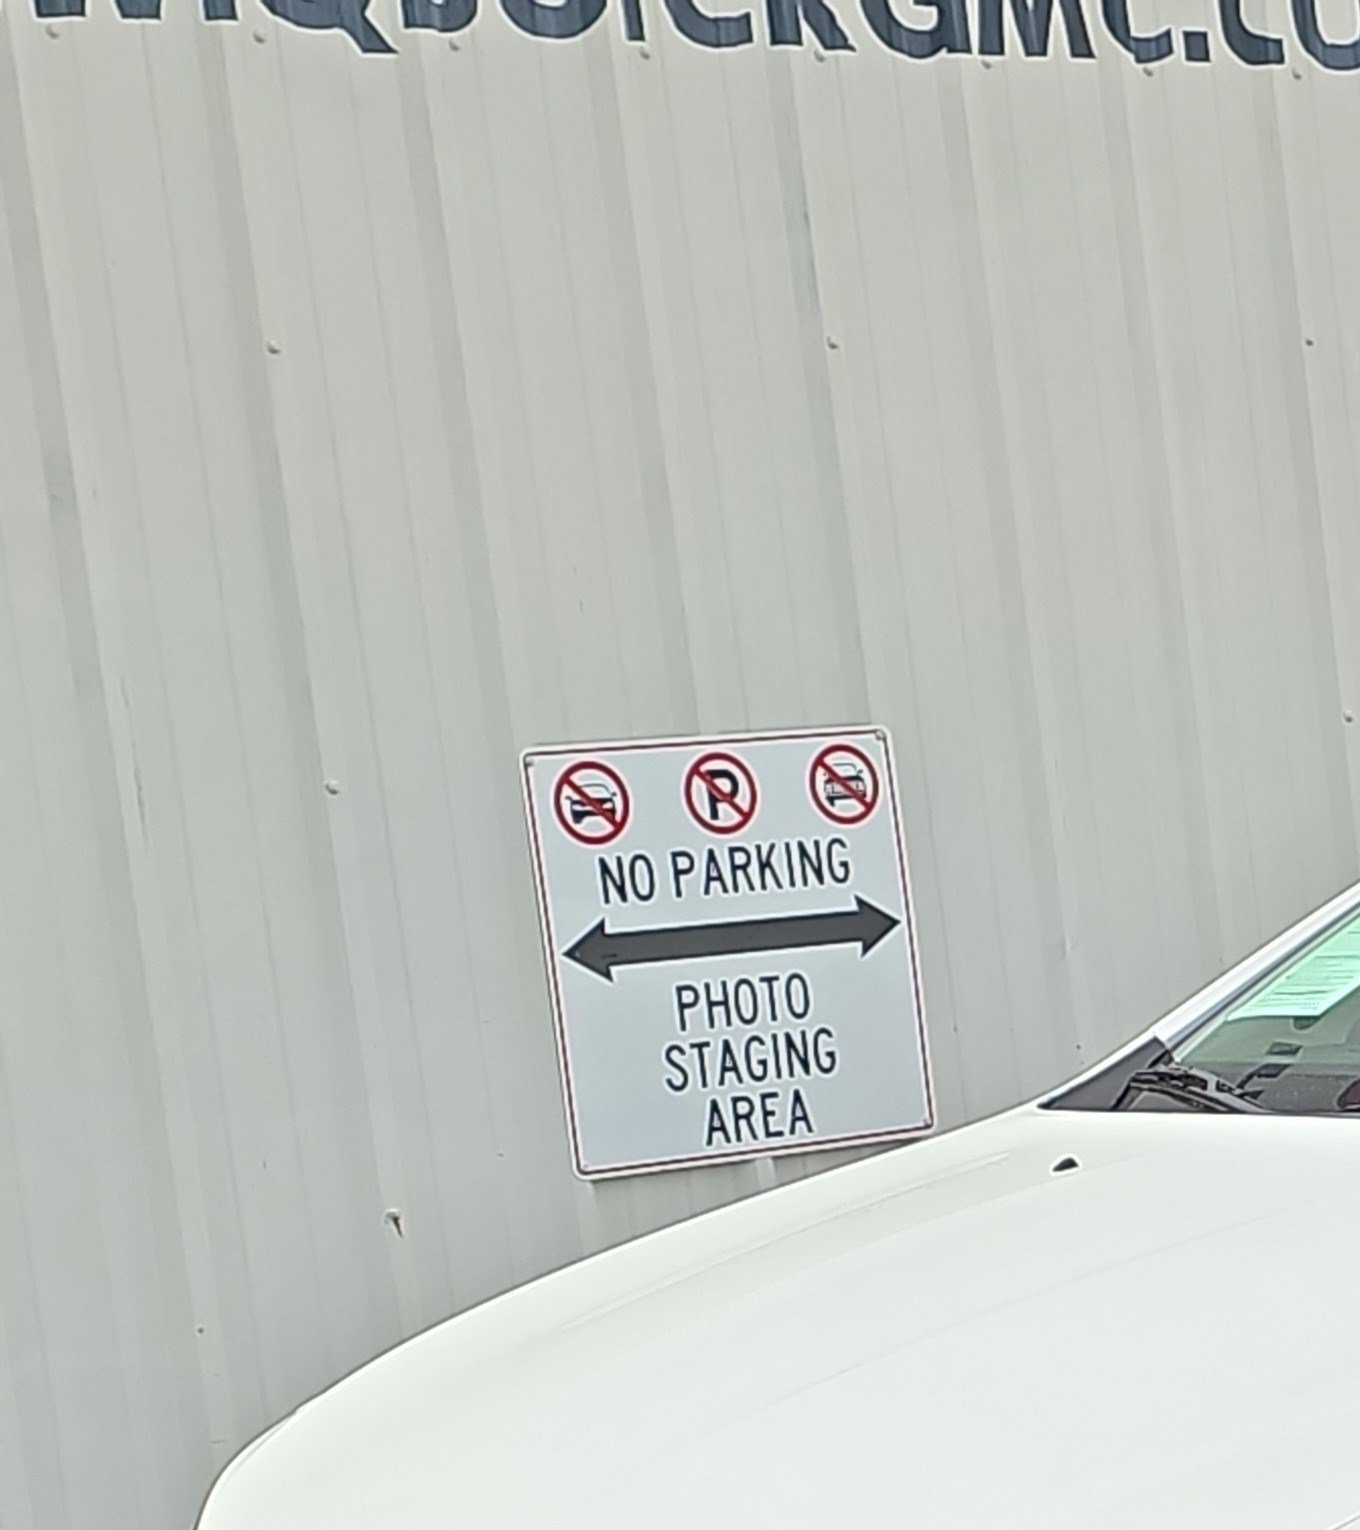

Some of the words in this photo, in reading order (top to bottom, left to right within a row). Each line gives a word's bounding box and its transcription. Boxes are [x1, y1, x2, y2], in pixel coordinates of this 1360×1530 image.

[598, 854, 655, 904] NO
[670, 838, 851, 898] PARKING
[675, 973, 811, 1031] PHOTO
[665, 1028, 837, 1092] STAGING
[705, 1089, 814, 1147] AREA
